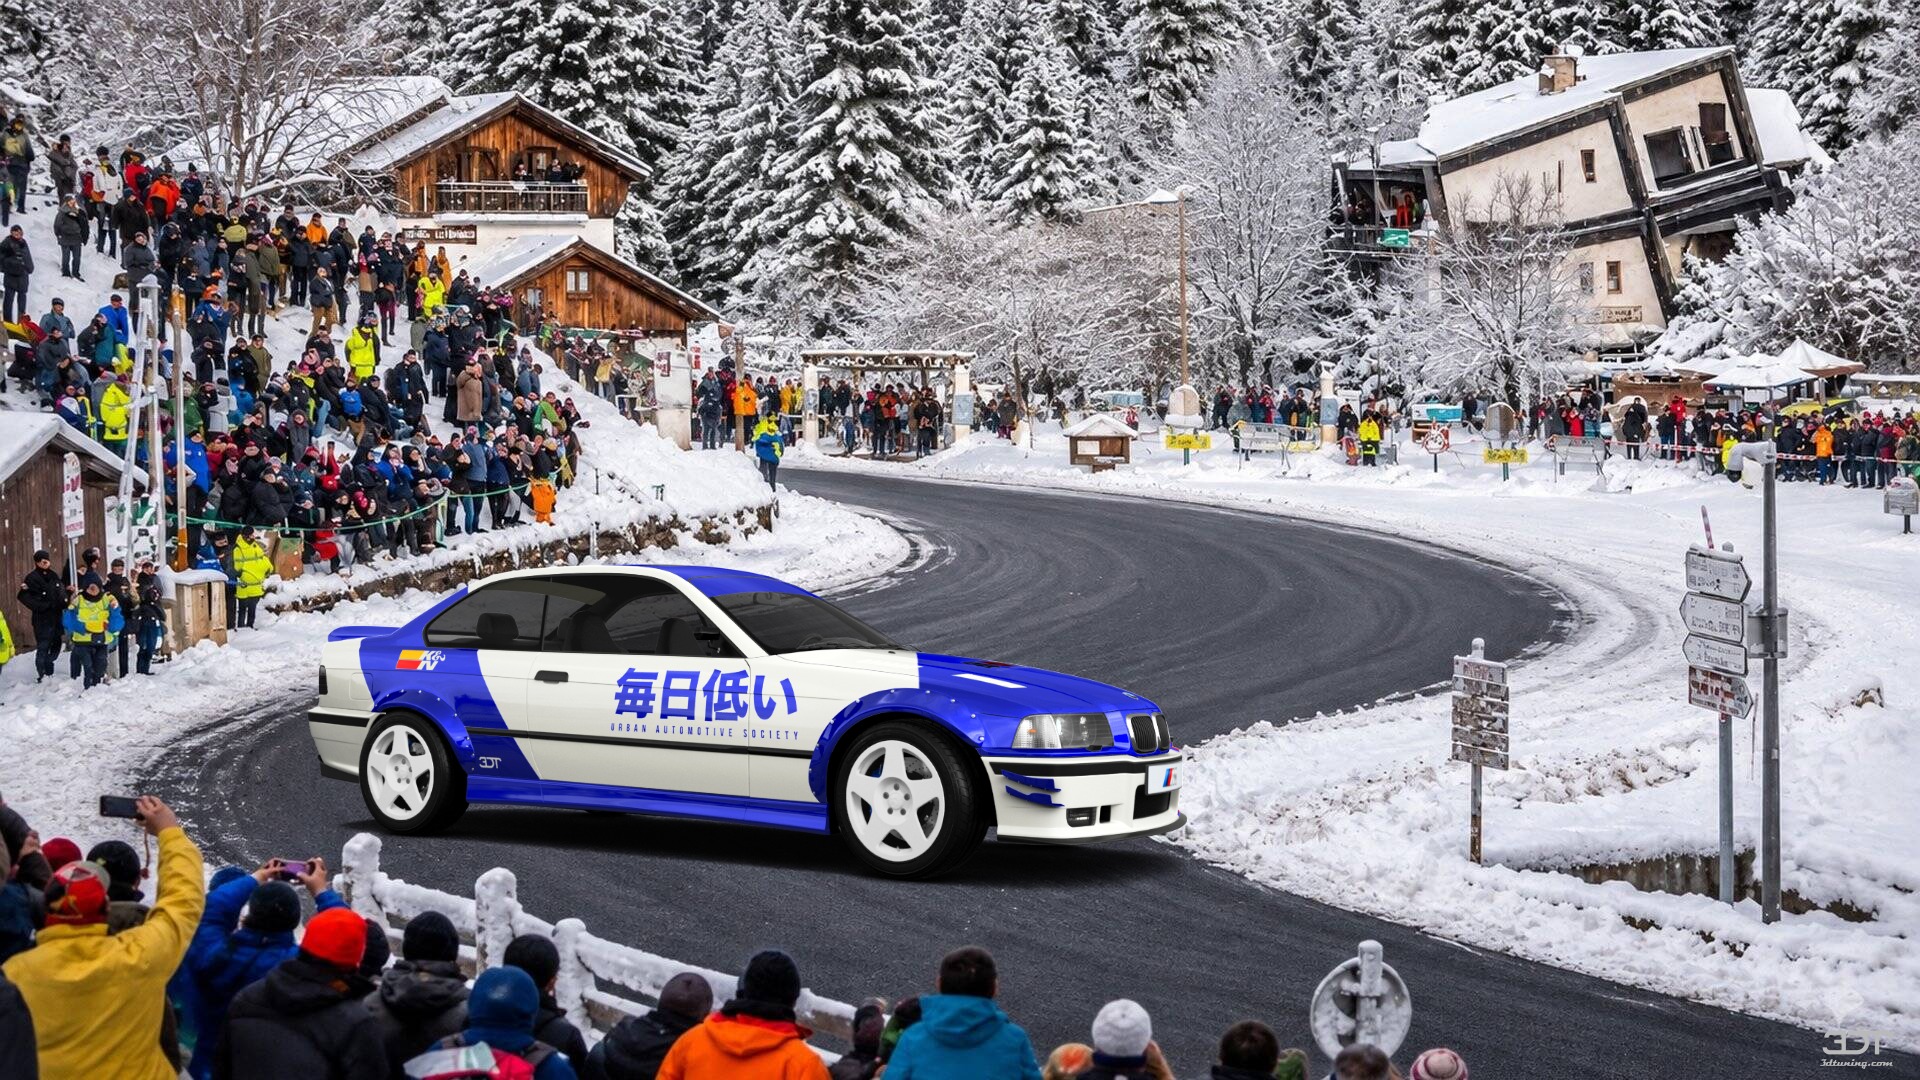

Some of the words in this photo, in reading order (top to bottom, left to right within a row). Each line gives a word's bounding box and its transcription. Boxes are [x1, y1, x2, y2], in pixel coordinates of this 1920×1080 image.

[615, 668, 797, 721] 毎日低い
[610, 723, 647, 733] URBAN
[655, 725, 733, 737] AUTOMOTIVE
[743, 728, 799, 740] SOCIETY
